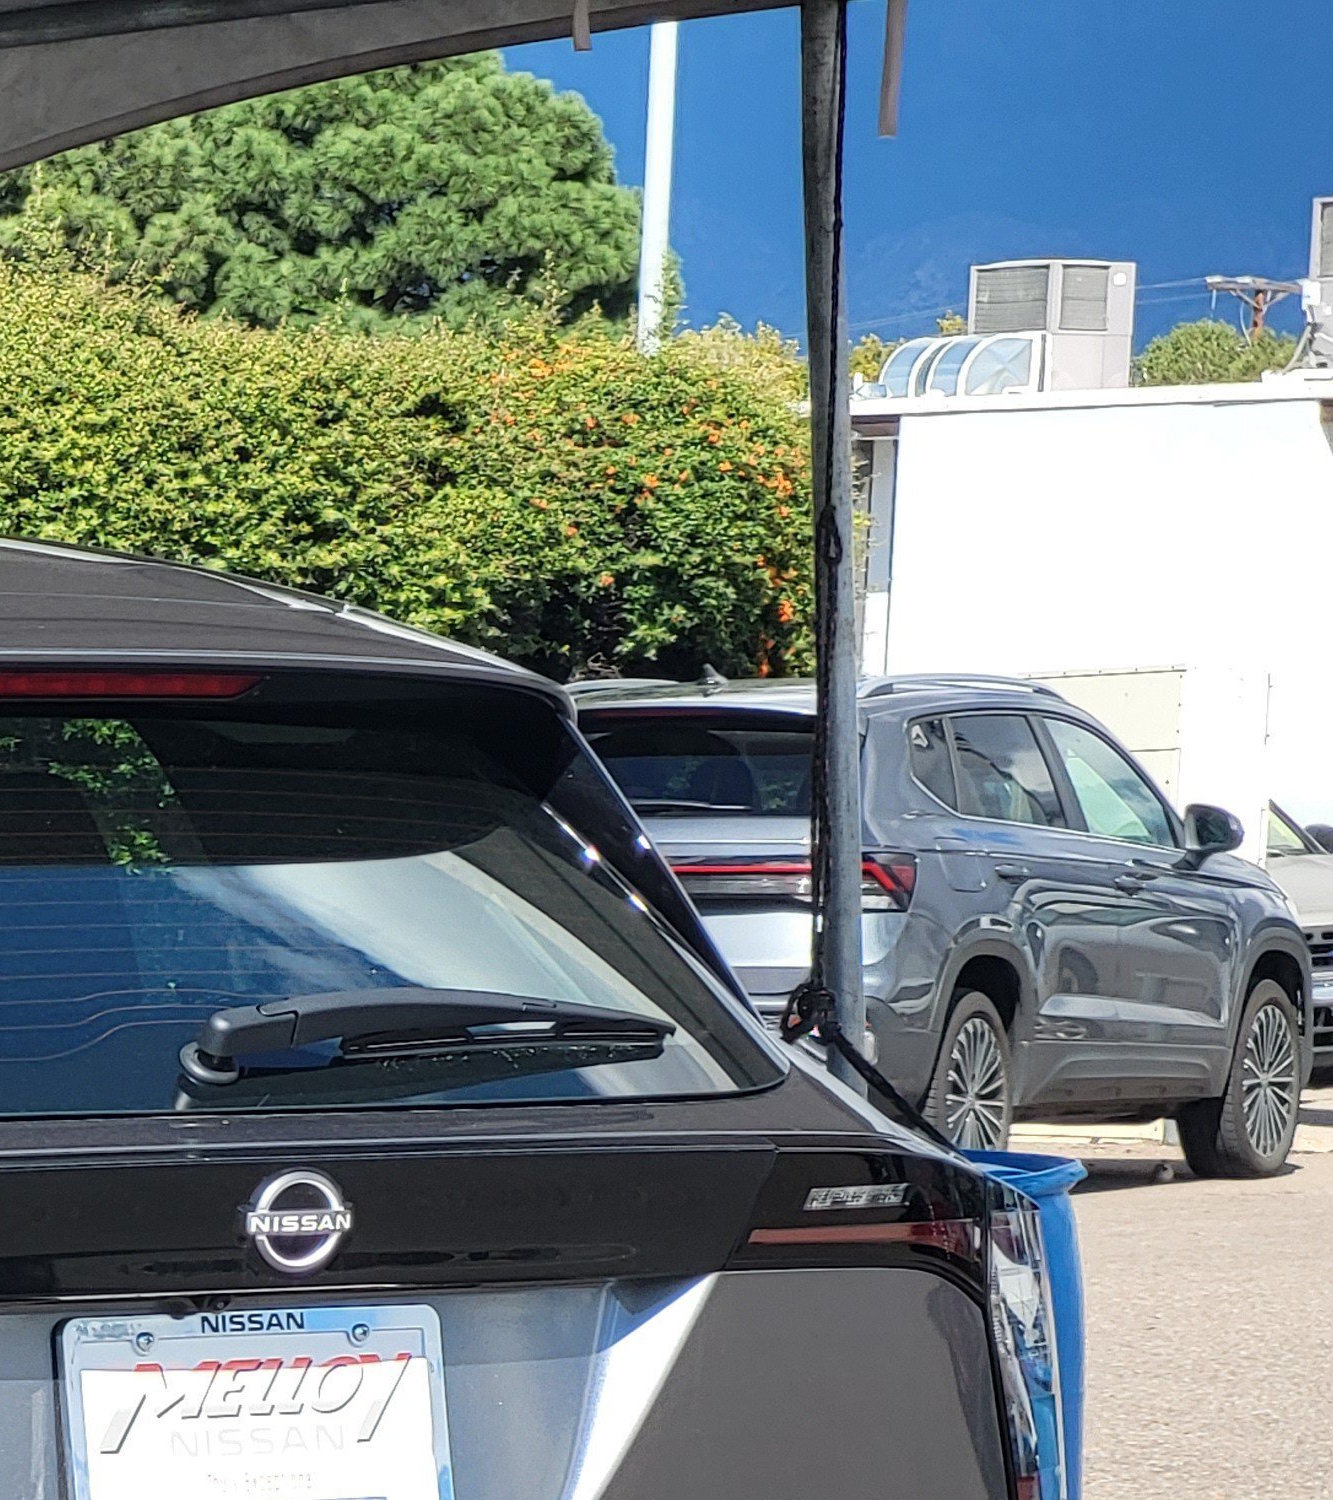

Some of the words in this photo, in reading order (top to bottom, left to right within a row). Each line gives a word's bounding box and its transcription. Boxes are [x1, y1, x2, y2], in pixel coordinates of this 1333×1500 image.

[249, 1209, 352, 1234] NISSAN
[201, 1311, 305, 1334] NISSAN
[100, 1352, 412, 1455] MELLOY
[170, 1424, 345, 1459] NISSAN
